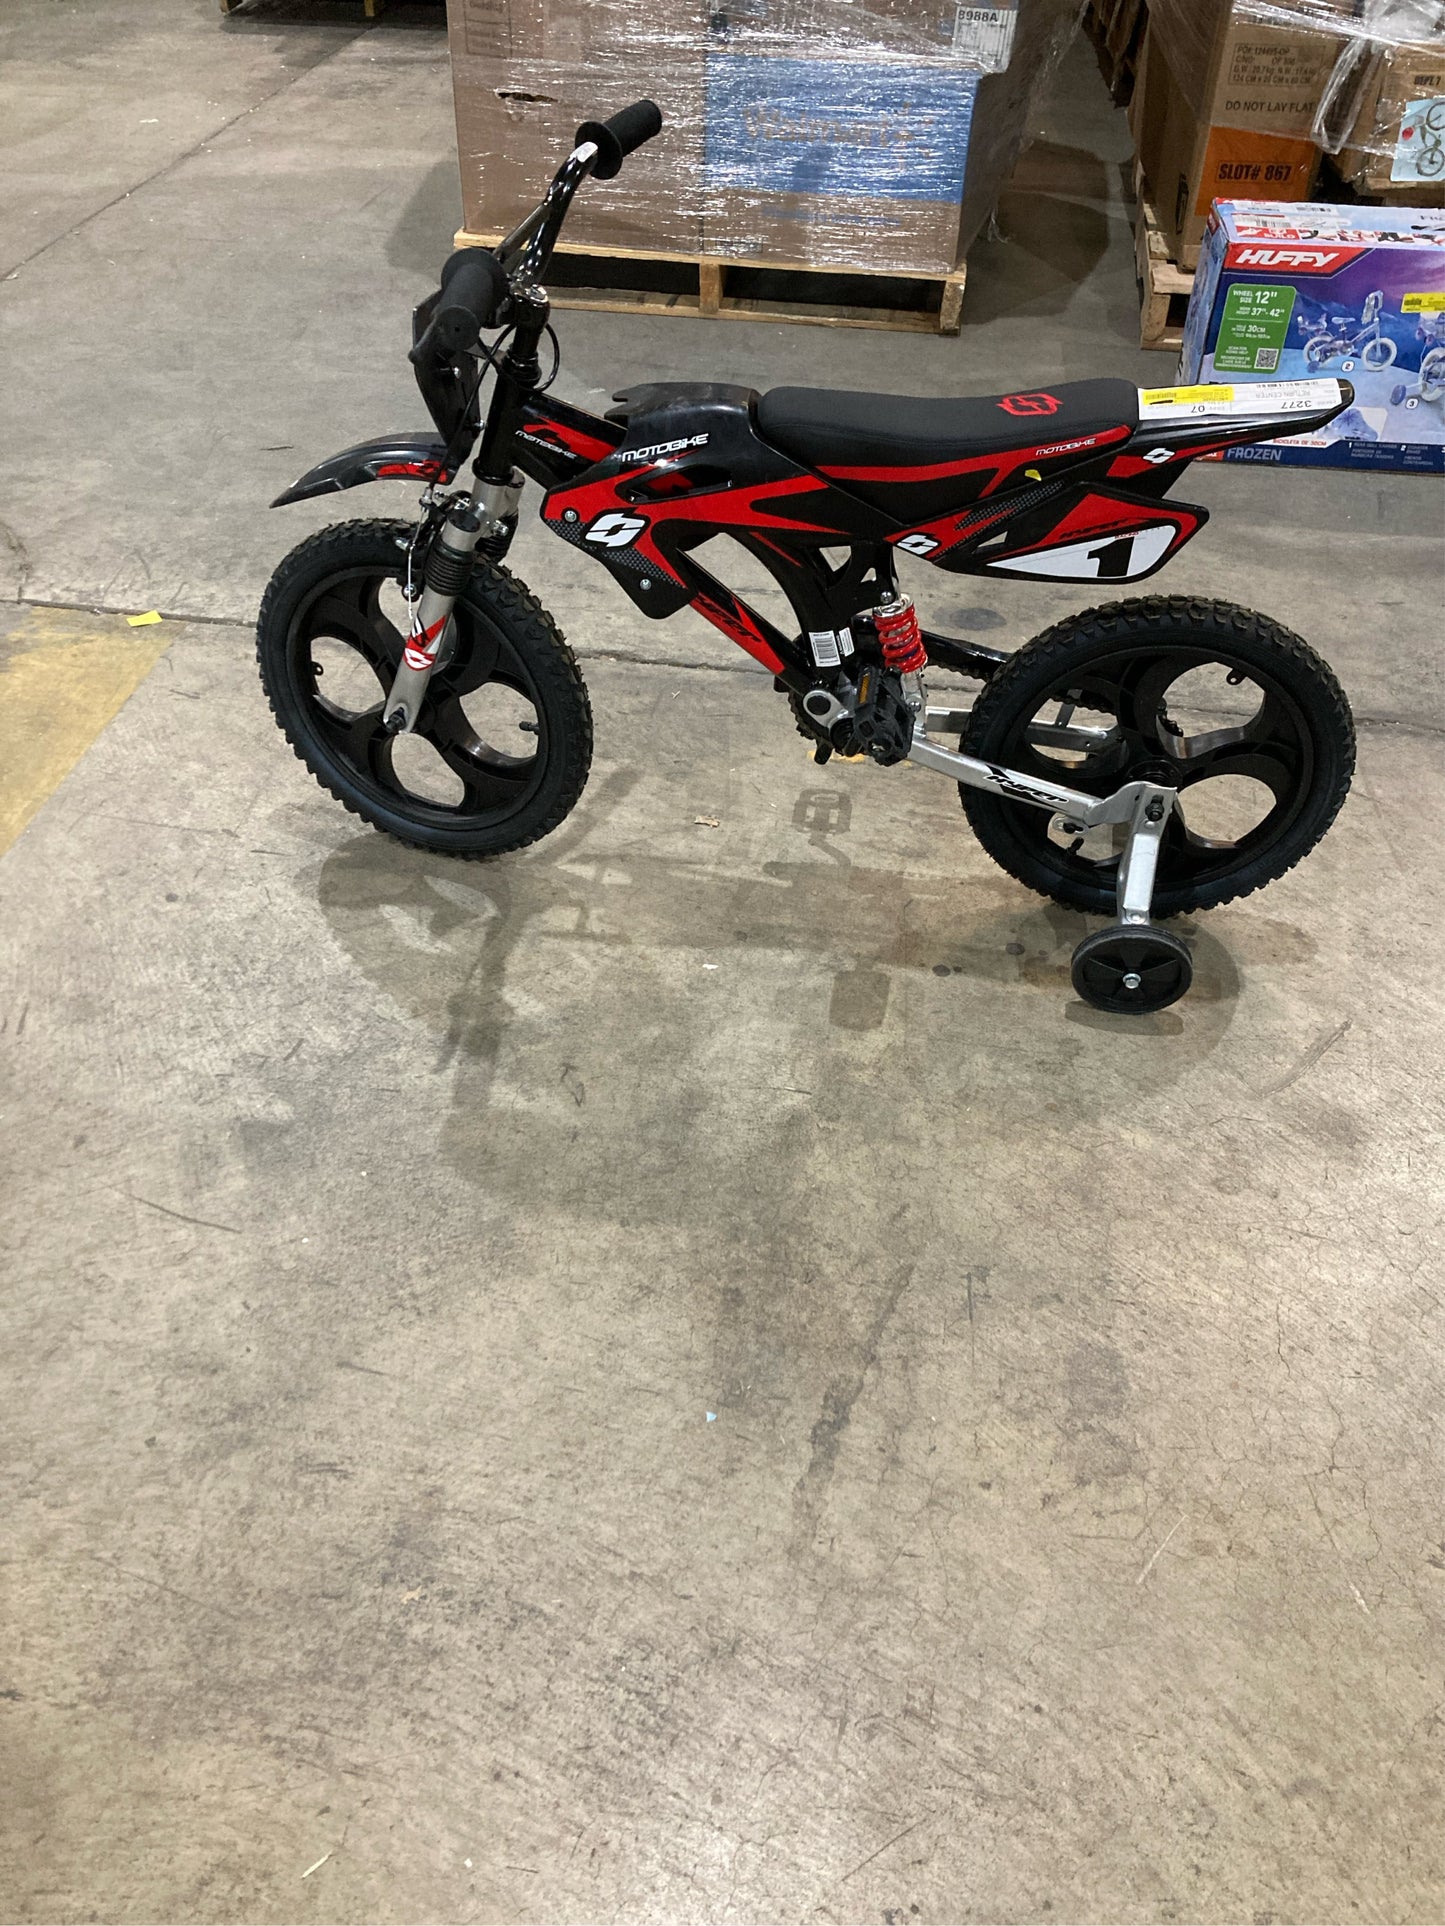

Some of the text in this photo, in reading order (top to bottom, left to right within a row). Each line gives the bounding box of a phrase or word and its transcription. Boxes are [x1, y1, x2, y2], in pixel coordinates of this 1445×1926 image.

[1225, 100, 1314, 113] DO NOT LAY FLAT
[1218, 163, 1292, 182] SLOT# 867
[1235, 249, 1339, 267] HUFFY
[1190, 405, 1206, 414] 07
[1280, 400, 1312, 410] 3277
[1227, 447, 1282, 460] FROZEN
[1086, 536, 1135, 578] 1
